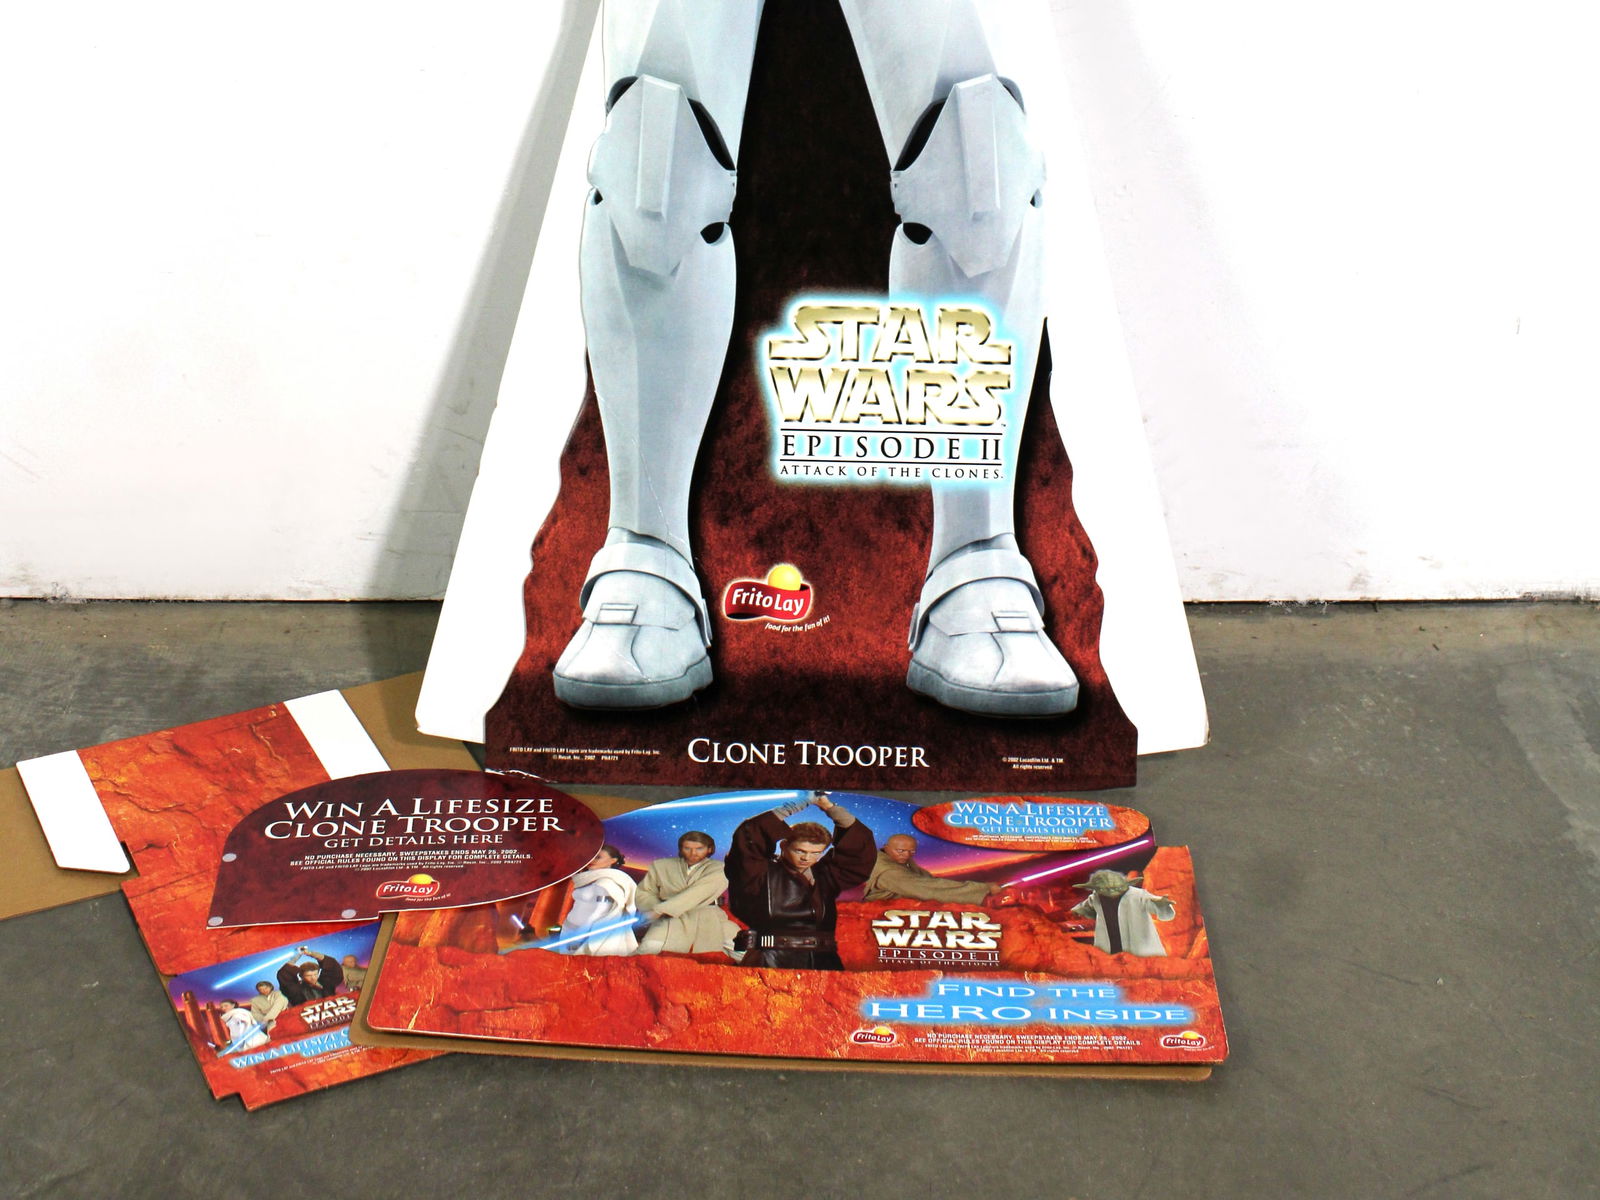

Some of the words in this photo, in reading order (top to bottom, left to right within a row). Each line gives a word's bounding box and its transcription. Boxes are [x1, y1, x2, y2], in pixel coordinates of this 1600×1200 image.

[768, 305, 1011, 365] STAR
[769, 366, 1010, 426] WARS
[782, 435, 960, 459] EPISODE
[981, 438, 1000, 460] II
[780, 465, 847, 476] ATTACK
[857, 466, 877, 476] OF
[888, 467, 921, 477] THE
[765, 623, 781, 631] food
[804, 623, 815, 631] fun
[687, 738, 786, 765] CLONE
[794, 740, 930, 768] TROOPER
[284, 801, 364, 820] WIN
[371, 798, 402, 816] A
[412, 798, 553, 815] LIFESIZE
[955, 802, 999, 814] WIN
[1006, 803, 1024, 815] A
[1025, 803, 1105, 816] LIFESIZE
[264, 819, 386, 839] CLONE
[397, 816, 565, 834] TROOPER
[947, 813, 1015, 826] CLONE
[1019, 814, 1112, 828] TROOPER
[324, 838, 363, 849] GET
[369, 835, 446, 846] DETAILS
[453, 834, 503, 844] HERE
[872, 910, 1001, 930] STAR
[872, 928, 1002, 949] WARS
[880, 949, 977, 960] EPISODE
[988, 952, 999, 961] II
[938, 984, 1035, 997] FIND
[1048, 988, 1116, 998] THE
[300, 996, 356, 1017] STAR
[302, 1001, 357, 1024] WARS
[871, 1002, 1032, 1020] HERO
[1049, 1007, 1187, 1020] INSIDE
